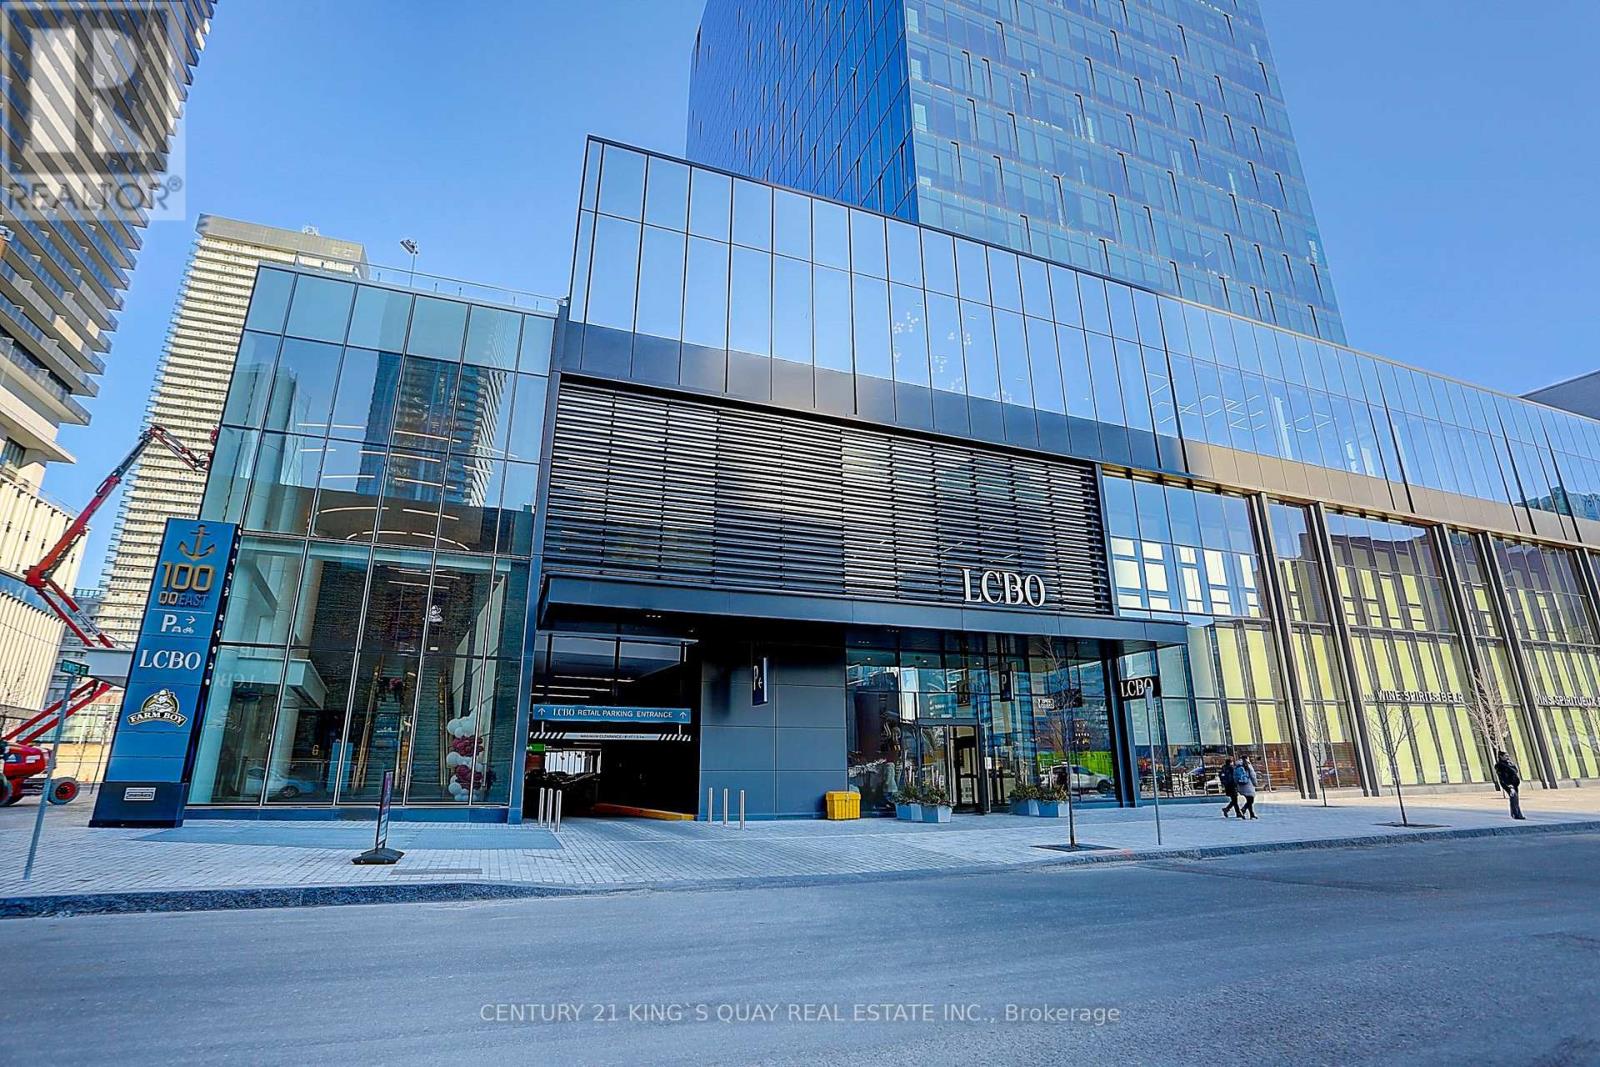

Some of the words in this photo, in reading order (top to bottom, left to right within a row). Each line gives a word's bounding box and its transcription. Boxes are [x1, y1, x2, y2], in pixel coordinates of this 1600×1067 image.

[161, 561, 214, 591] 100
[962, 568, 1046, 607] LCBO
[160, 614, 177, 632] P
[139, 649, 202, 670] LCBO
[1120, 678, 1154, 697] LCBO
[1376, 689, 1403, 701] WINE
[129, 711, 162, 723] FARM
[164, 712, 187, 724] BOY
